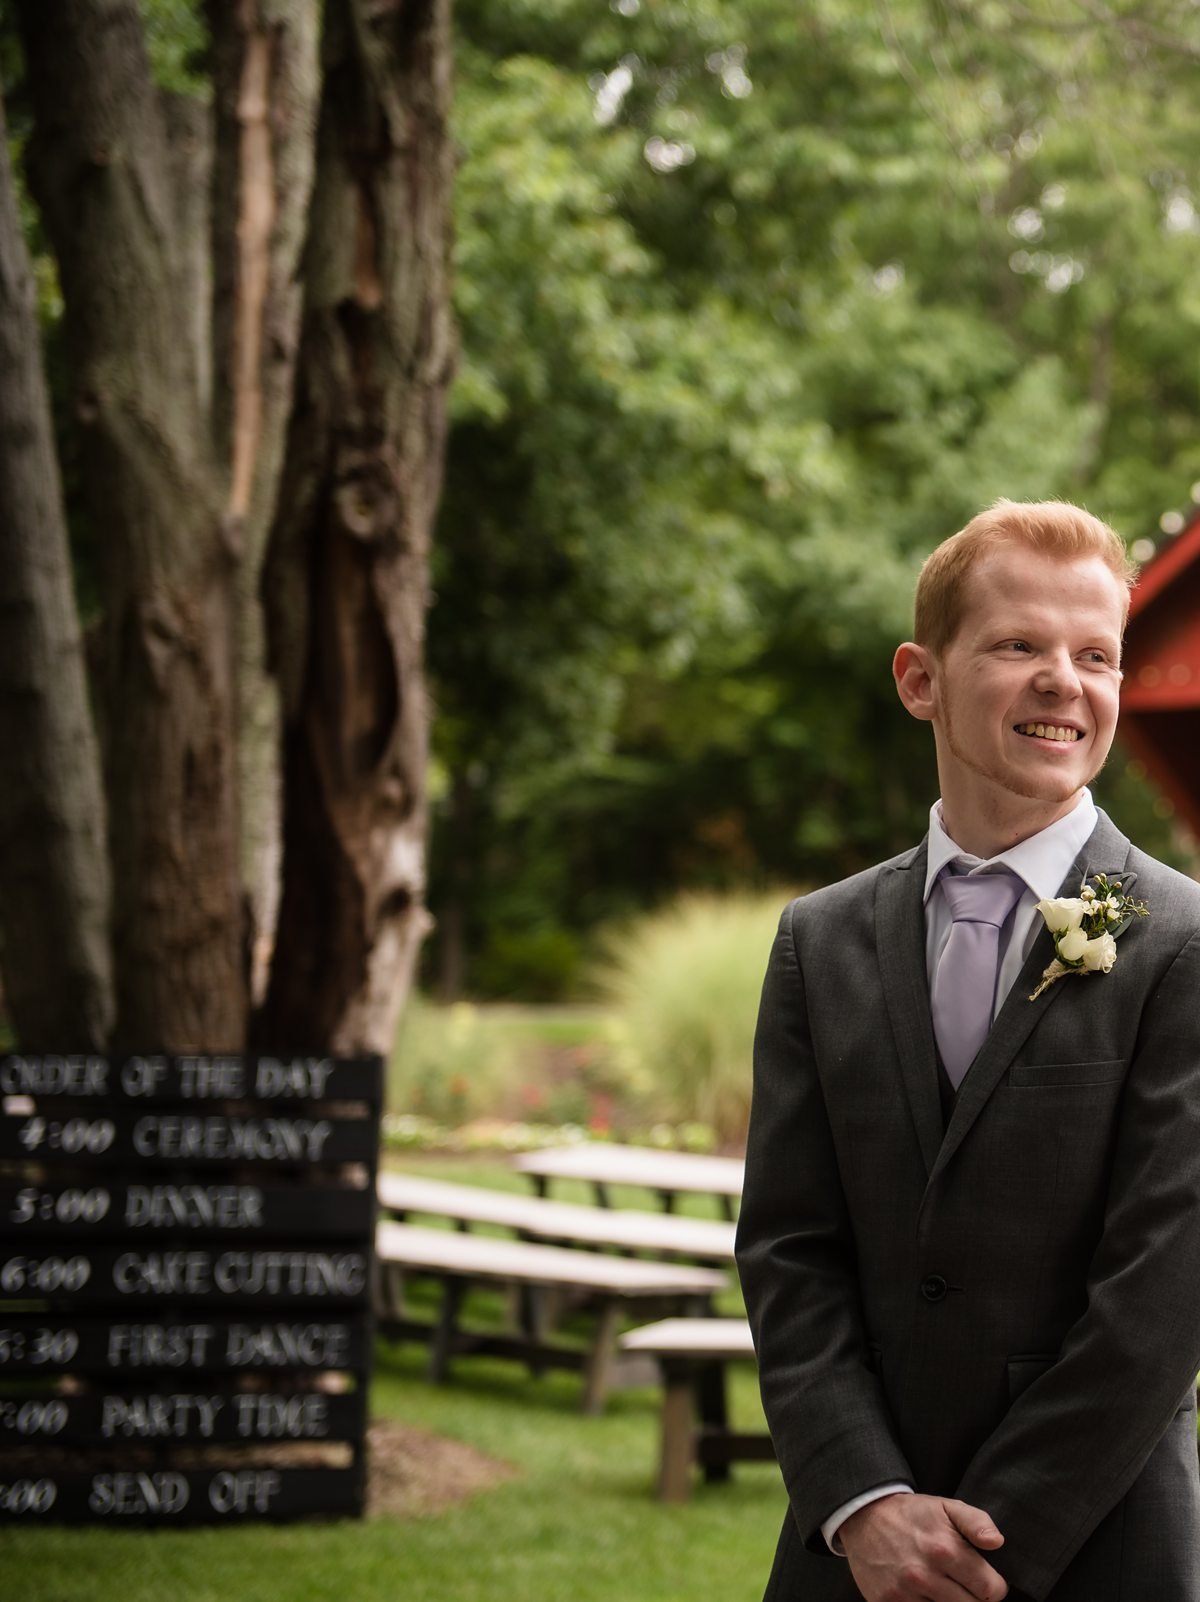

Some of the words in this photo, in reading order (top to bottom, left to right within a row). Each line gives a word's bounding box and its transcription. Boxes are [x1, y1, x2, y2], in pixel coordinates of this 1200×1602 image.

[121, 1056, 168, 1097] OF
[176, 1056, 246, 1099] THE
[256, 1057, 335, 1099] DAY
[20, 1116, 116, 1154] 4:00
[133, 1115, 333, 1162] CEREMONY
[9, 1187, 111, 1224] 5:00
[125, 1185, 264, 1228] DINNER
[1, 1255, 91, 1293] 6:00
[112, 1252, 211, 1295] CAKE
[214, 1252, 367, 1296] CUTTING
[108, 1324, 214, 1367] FIRST
[226, 1323, 350, 1367] DANCE
[0, 1399, 69, 1436] :00
[101, 1394, 224, 1438] PARTY
[232, 1394, 330, 1438] TIME
[89, 1471, 190, 1515] SEND
[208, 1470, 282, 1514] OFF
